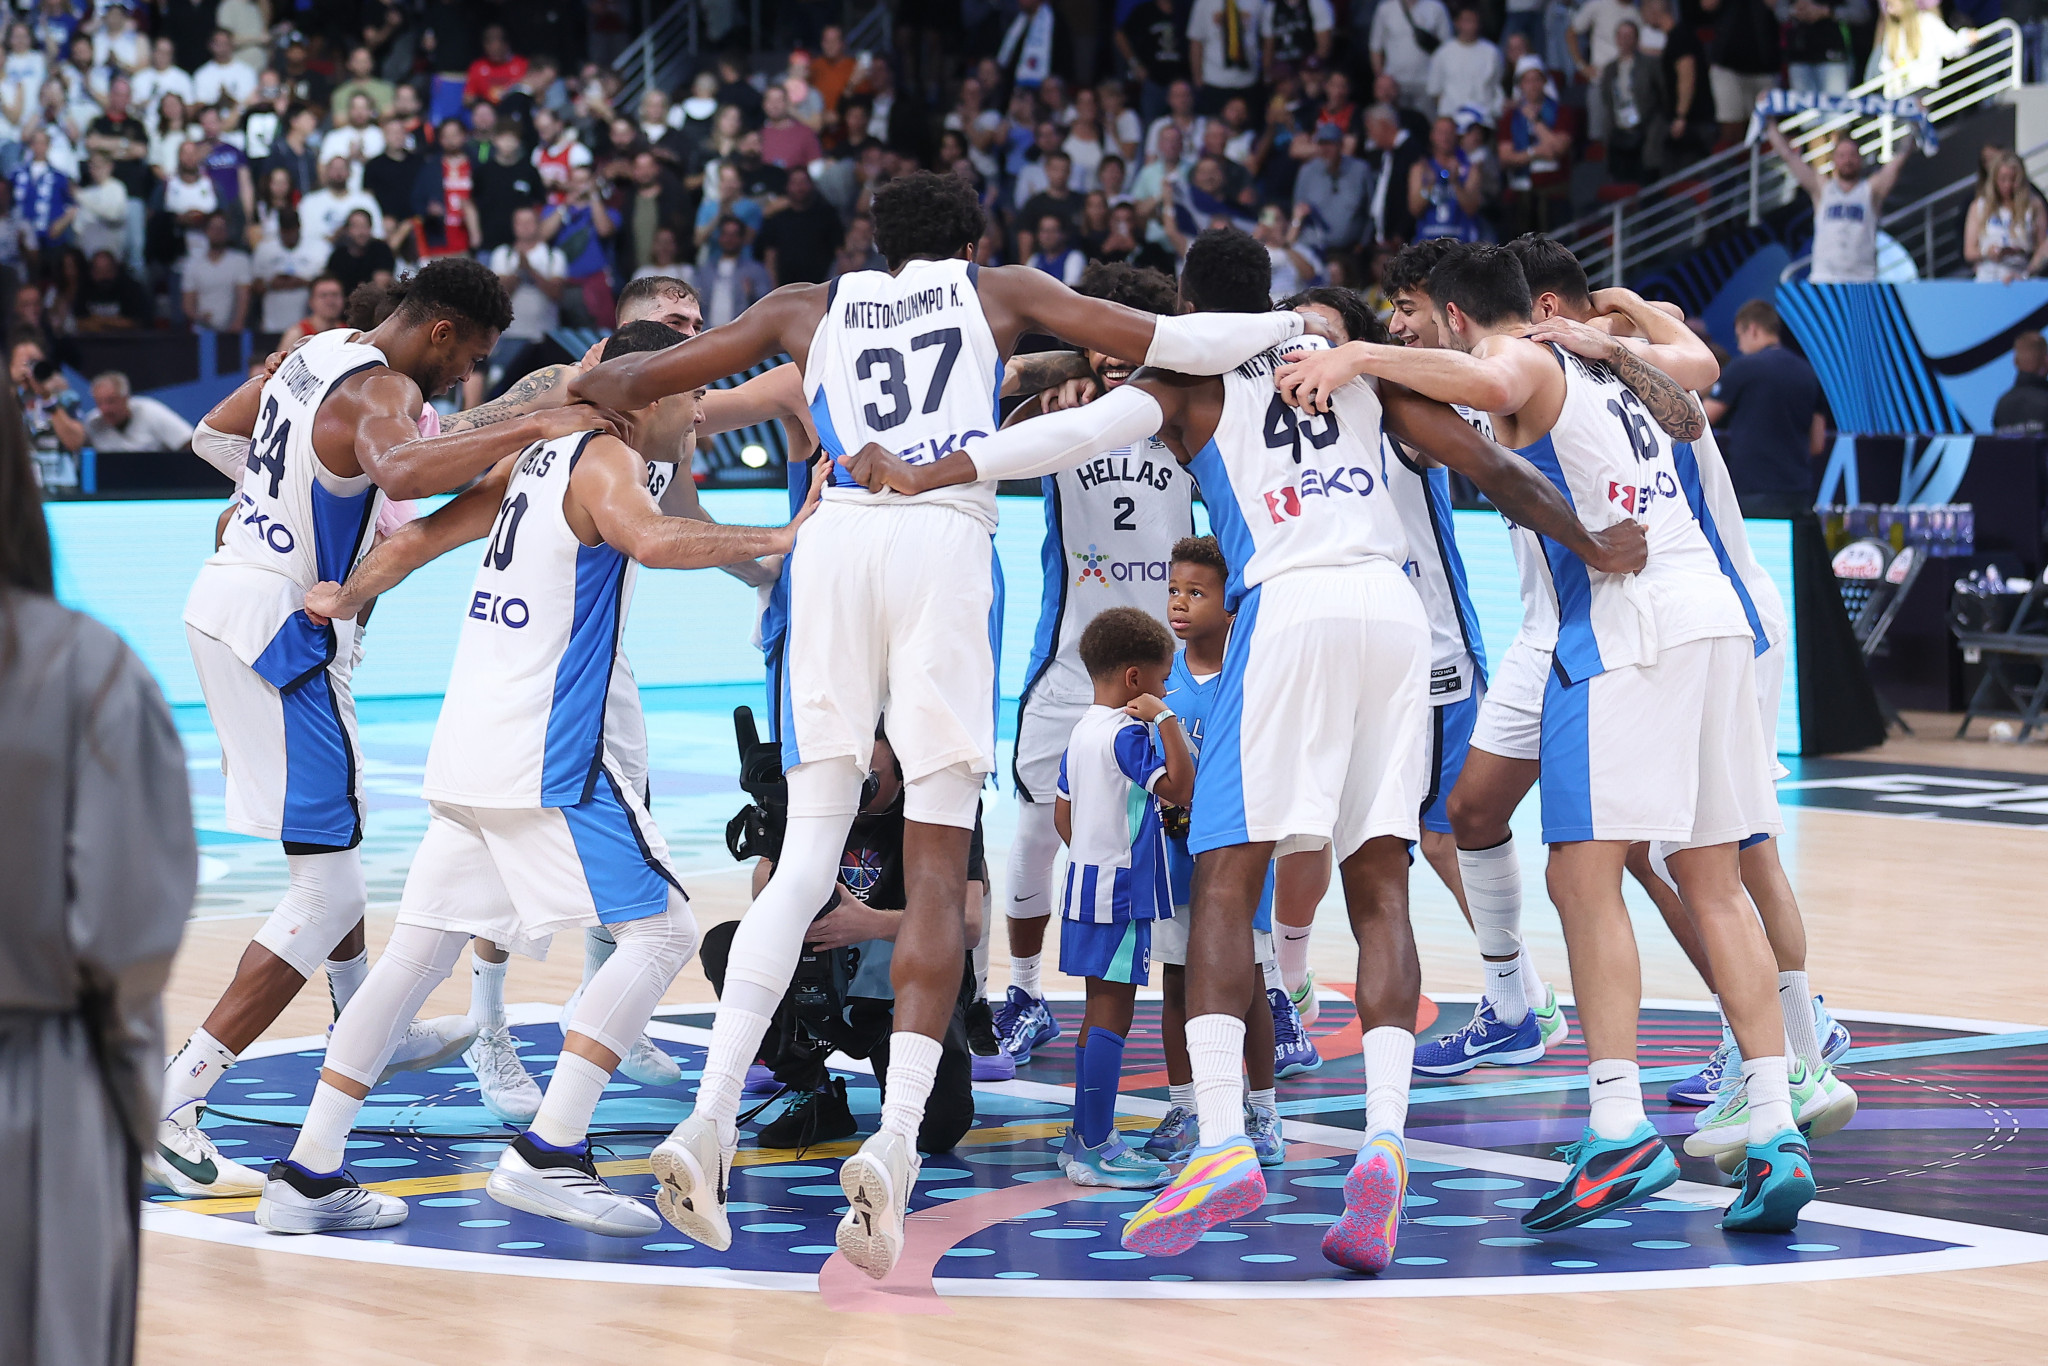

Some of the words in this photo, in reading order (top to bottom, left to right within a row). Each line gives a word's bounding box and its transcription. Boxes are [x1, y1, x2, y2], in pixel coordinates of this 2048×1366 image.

[844, 286, 943, 329] ANTETOKOUNMPO
[950, 282, 964, 307] K.
[855, 326, 963, 432] 37
[1606, 388, 1660, 465] 16
[1076, 457, 1173, 491] HELLAS
[1300, 466, 1374, 499] EKO
[482, 491, 529, 572] 10
[1113, 496, 1137, 531] 2
[468, 590, 530, 629] EKO
